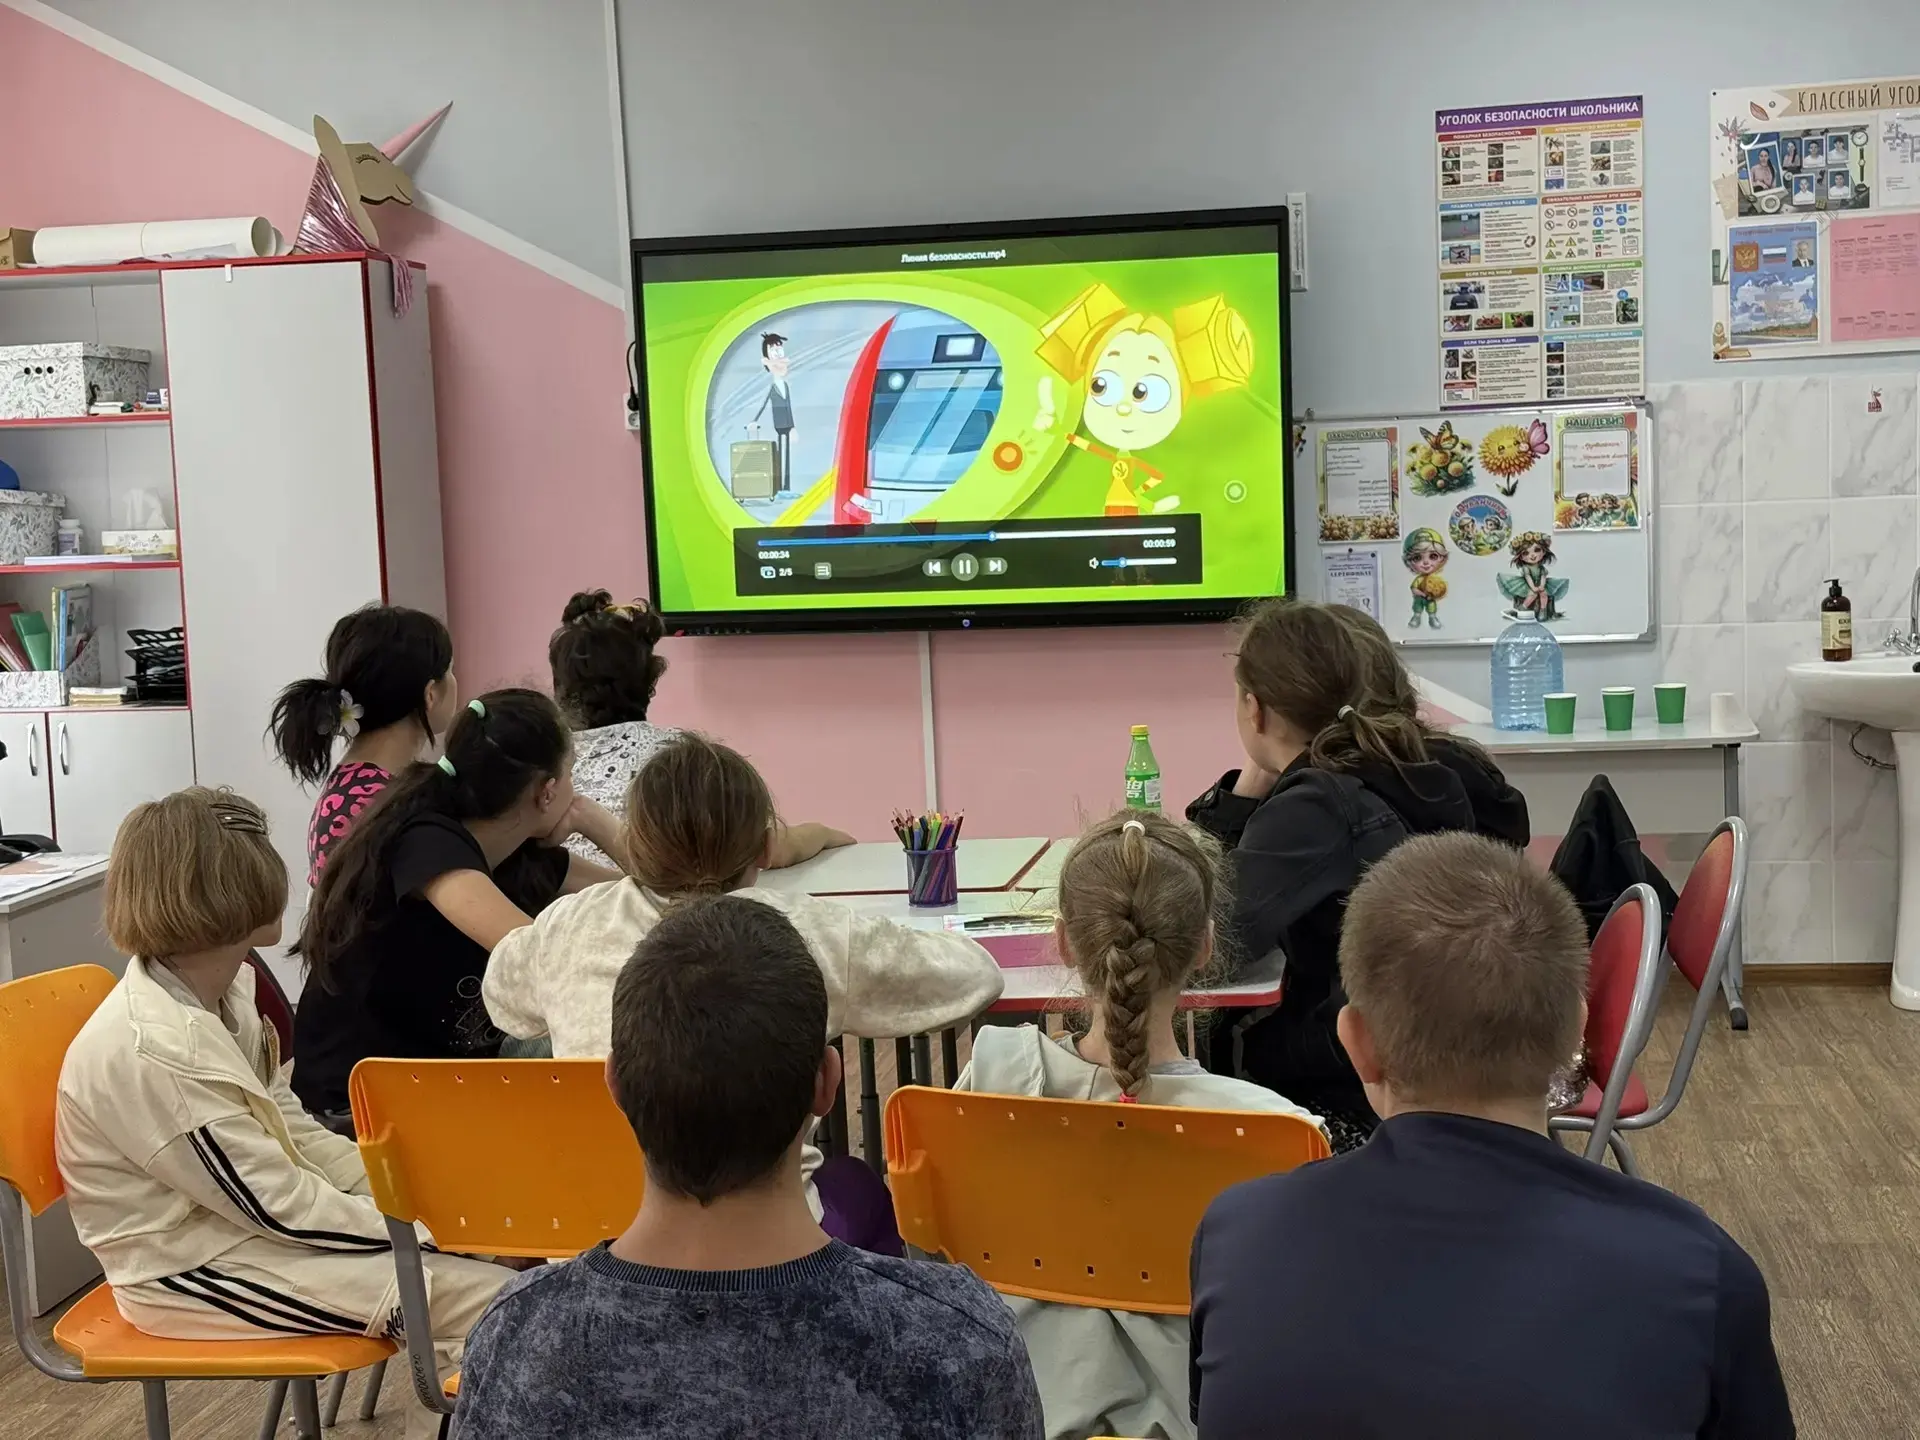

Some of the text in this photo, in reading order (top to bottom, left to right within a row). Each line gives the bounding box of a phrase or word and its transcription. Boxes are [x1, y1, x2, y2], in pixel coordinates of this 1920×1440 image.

[1798, 84, 1881, 113] КЛАССНЫЙ
[1439, 101, 1639, 126] УГОЛОК БЕЗОПАСНОСТИ ШКОЛЬНИКА
[901, 253, 929, 263] Линия
[1566, 416, 1588, 426] НАШ
